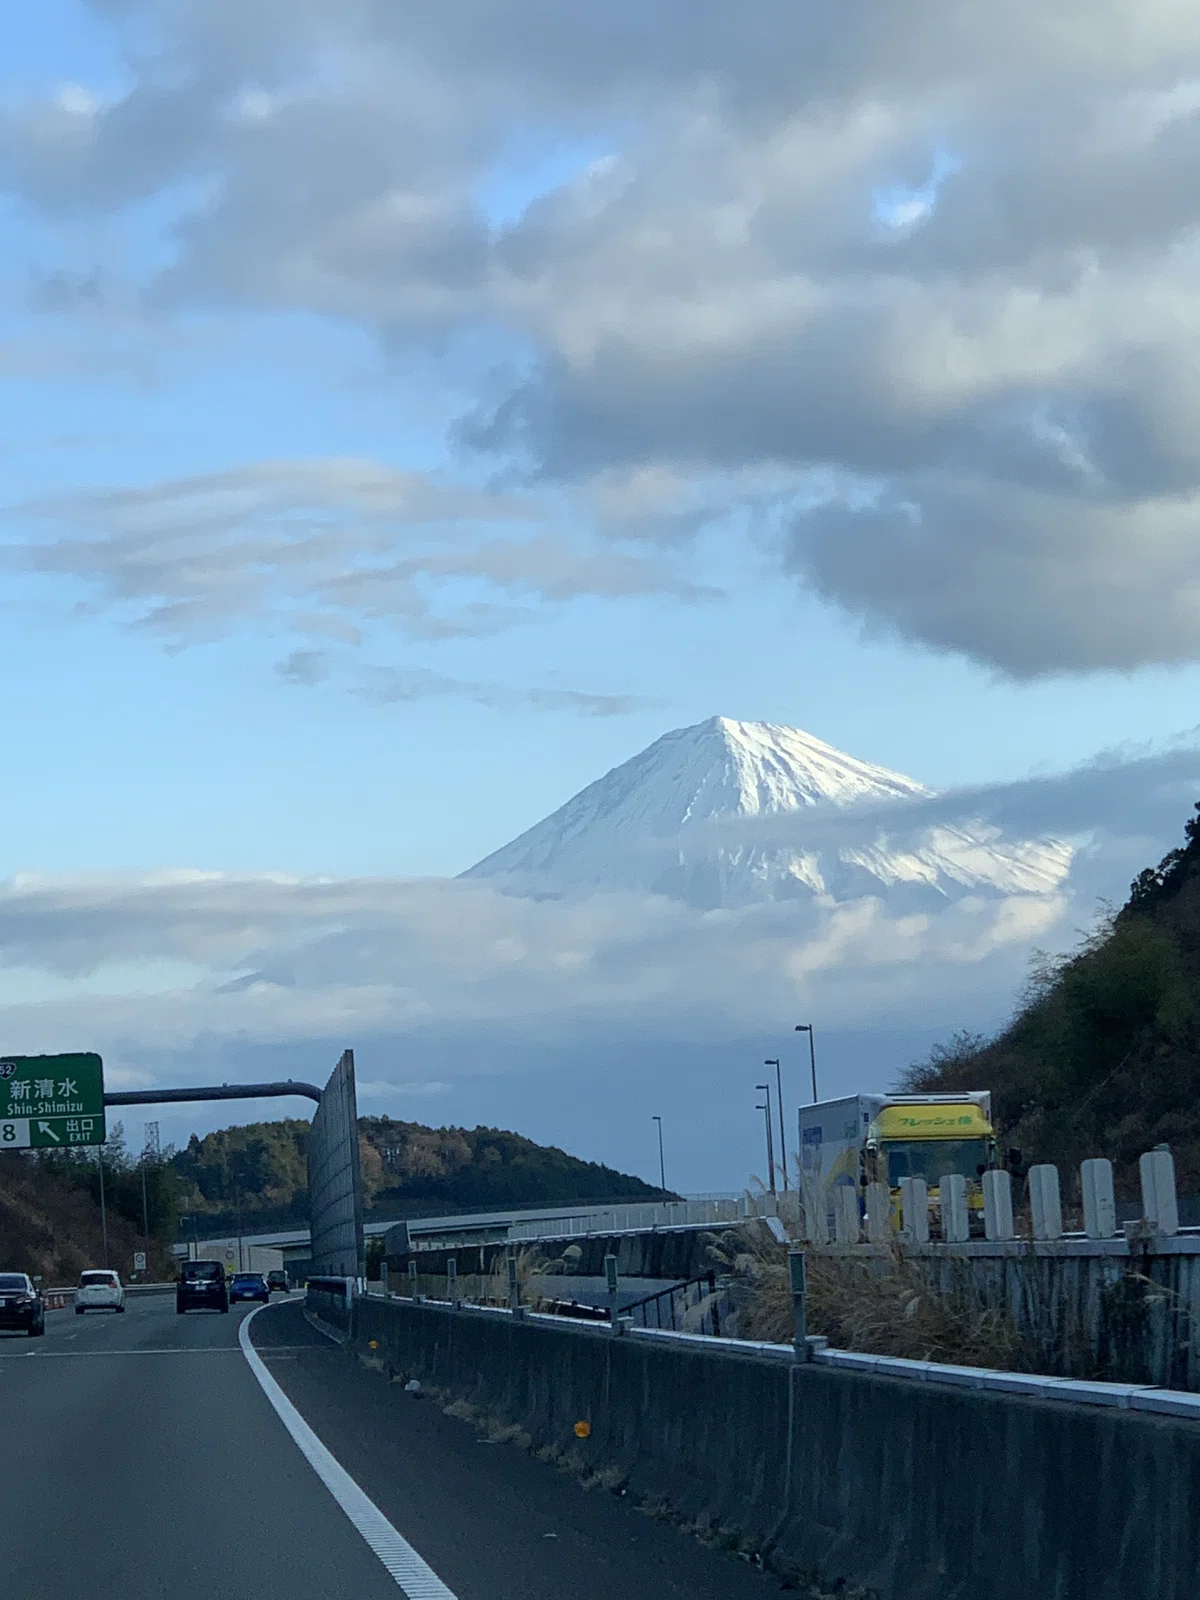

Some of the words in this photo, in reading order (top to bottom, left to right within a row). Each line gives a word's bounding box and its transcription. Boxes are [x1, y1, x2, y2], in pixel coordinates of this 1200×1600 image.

[0, 1065, 12, 1075] 52
[9, 1077, 78, 1100] 新清水
[7, 1100, 83, 1115] Shin-Shimizu
[2, 1123, 16, 1142] 8
[66, 1119, 93, 1132] 出口
[69, 1132, 91, 1142] EXIT
